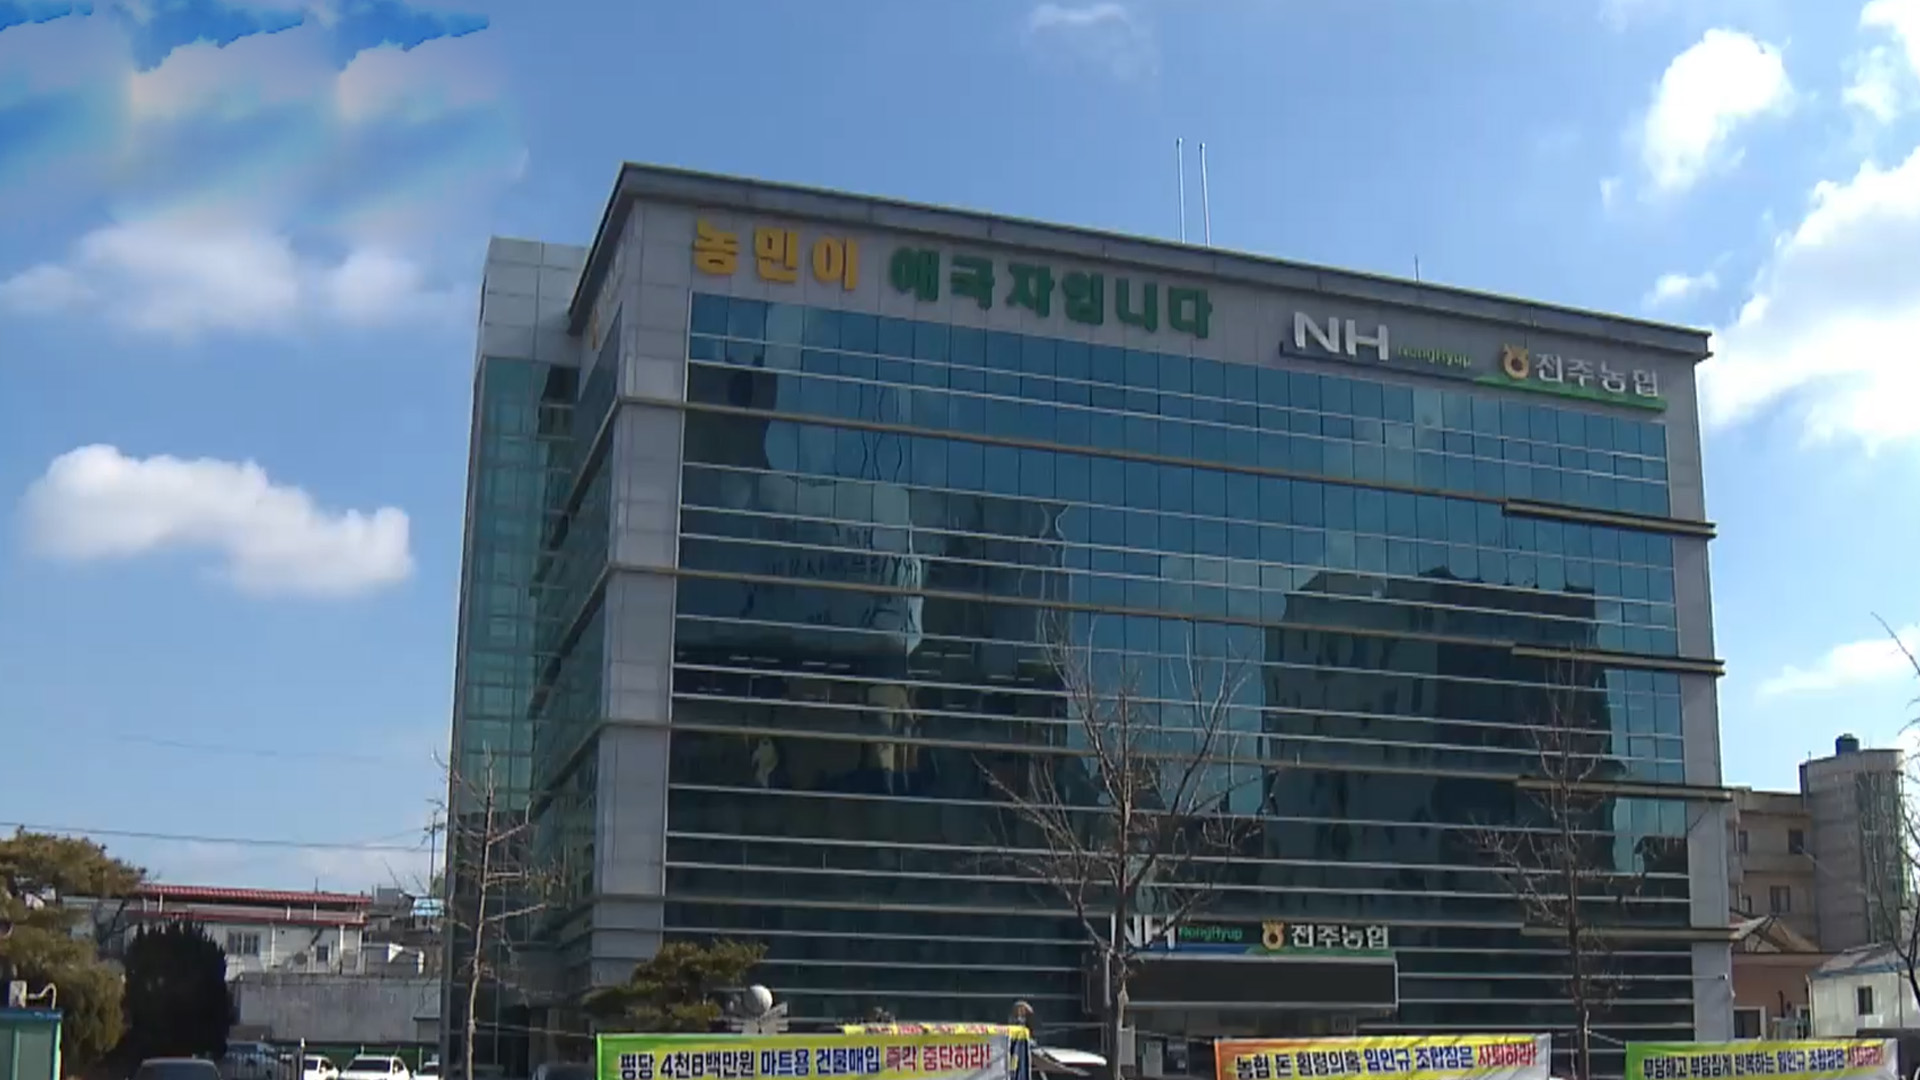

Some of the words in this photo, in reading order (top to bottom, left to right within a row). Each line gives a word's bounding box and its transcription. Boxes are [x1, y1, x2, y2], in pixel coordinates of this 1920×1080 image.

[692, 217, 859, 291] 농민이
[888, 246, 1213, 339] 애국자입니다
[1293, 311, 1390, 361] NH
[1535, 353, 1660, 398] 전주농협
[1110, 913, 1175, 950] NH
[1291, 923, 1389, 950] 전주농협
[620, 1053, 654, 1080] 평당
[760, 1048, 809, 1076] 마트용
[816, 1046, 880, 1074] 건물매입
[885, 1045, 918, 1072] 즉각
[923, 1043, 991, 1071] 중단하라!
[1236, 1054, 1270, 1079] 농협
[1364, 1048, 1410, 1073] 임인규
